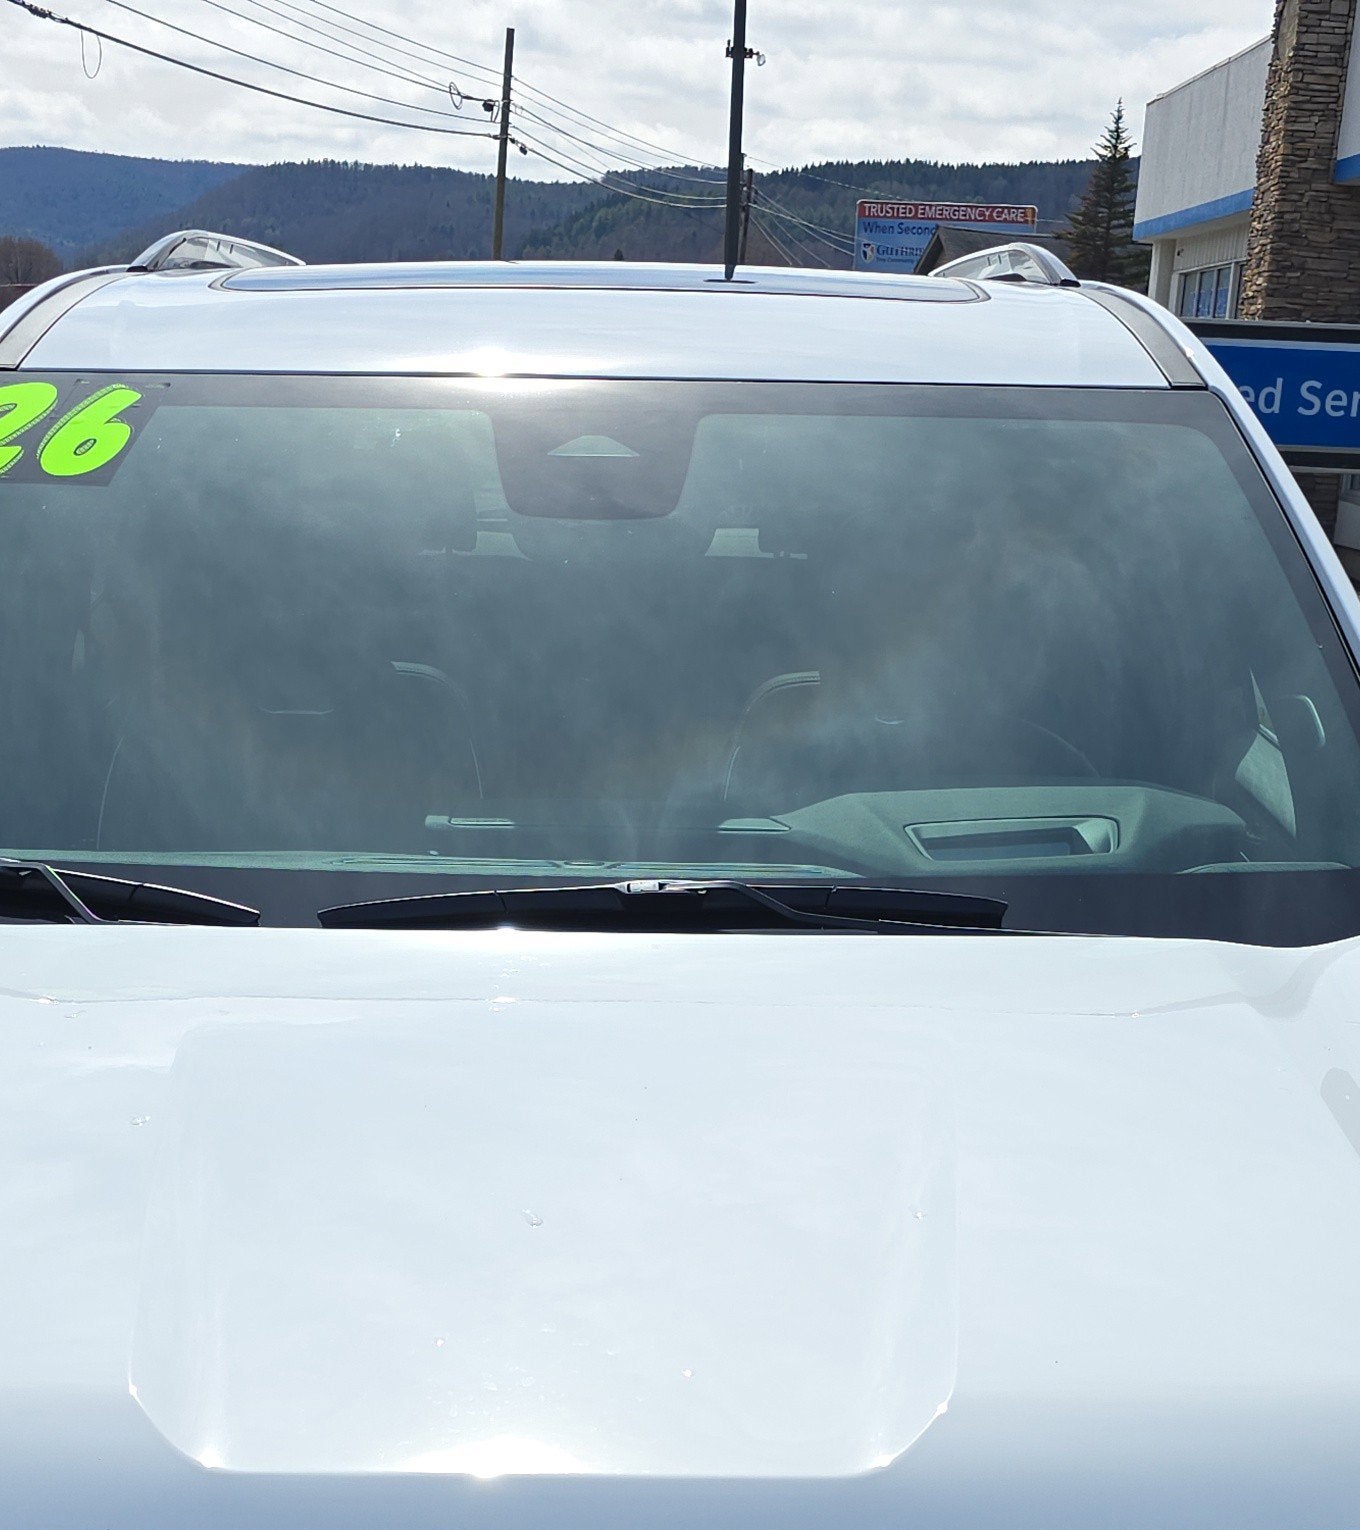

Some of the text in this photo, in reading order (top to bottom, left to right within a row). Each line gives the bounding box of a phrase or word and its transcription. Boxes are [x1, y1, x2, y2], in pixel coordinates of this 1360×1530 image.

[864, 203, 1024, 222] TRUSTED EMERGENCY CARE
[863, 221, 894, 234] When
